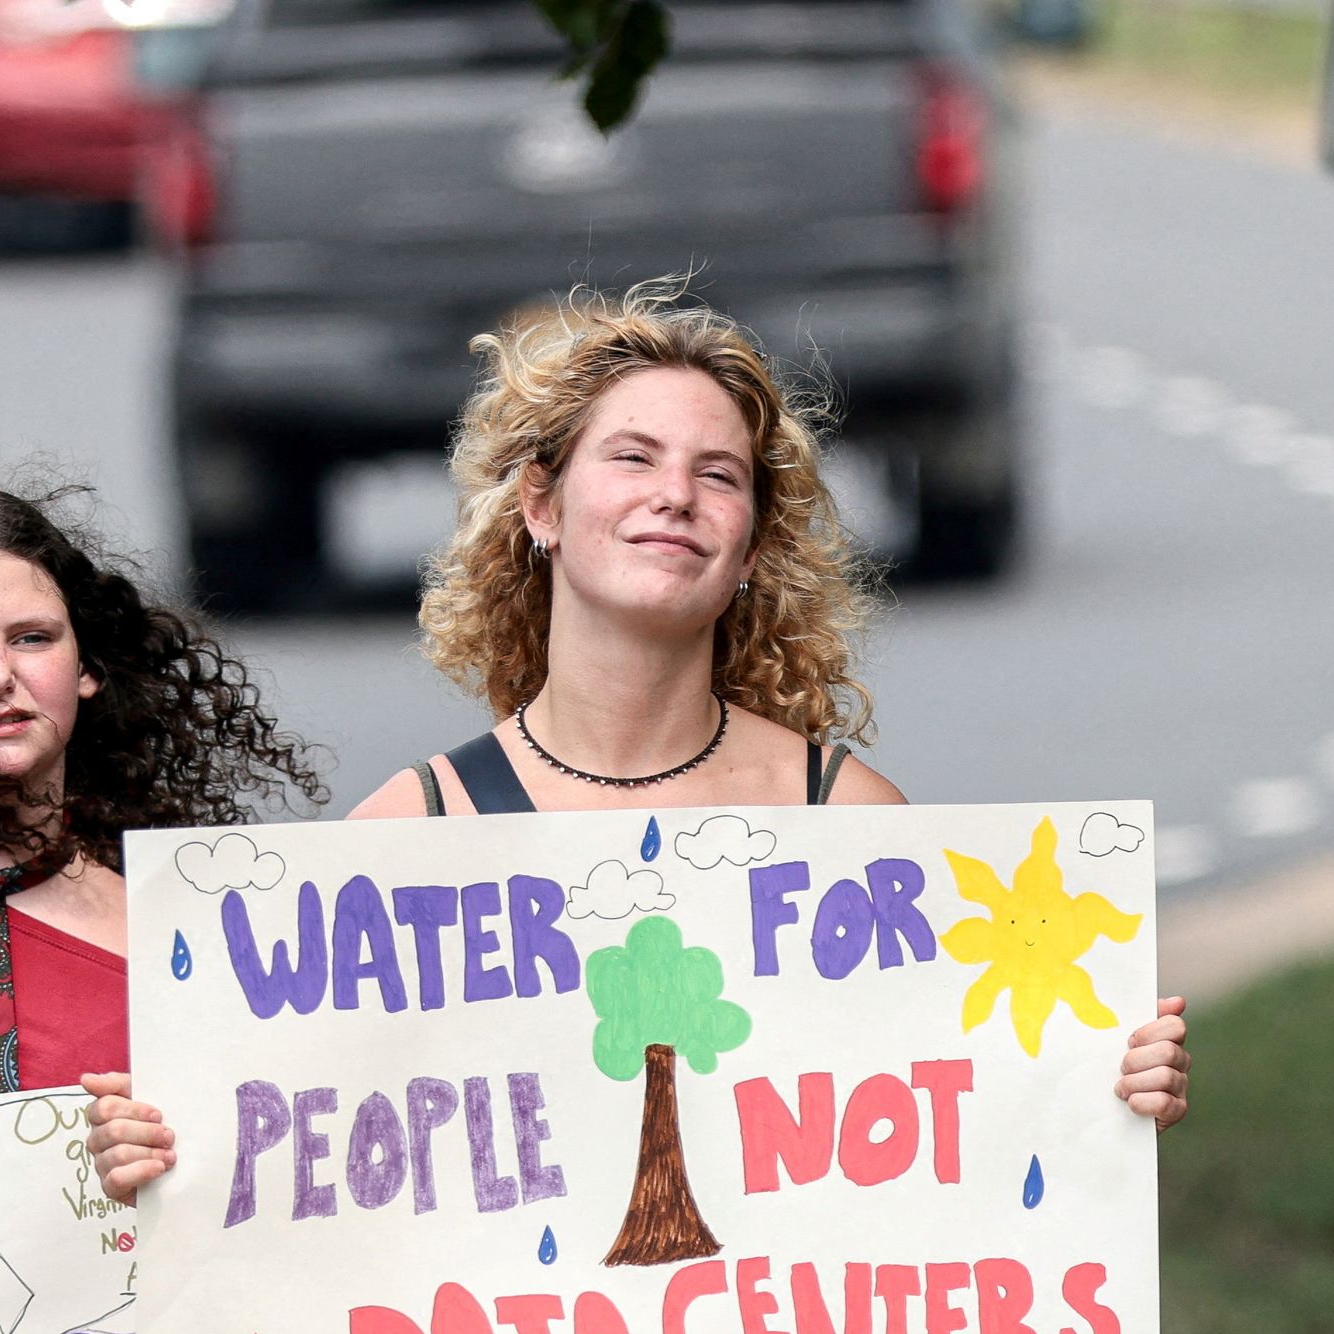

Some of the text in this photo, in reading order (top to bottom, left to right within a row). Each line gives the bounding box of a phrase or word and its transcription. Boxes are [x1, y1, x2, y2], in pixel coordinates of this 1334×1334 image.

[221, 857, 936, 1019] WATER FOR
[224, 1058, 973, 1228] PEOPLE NOT
